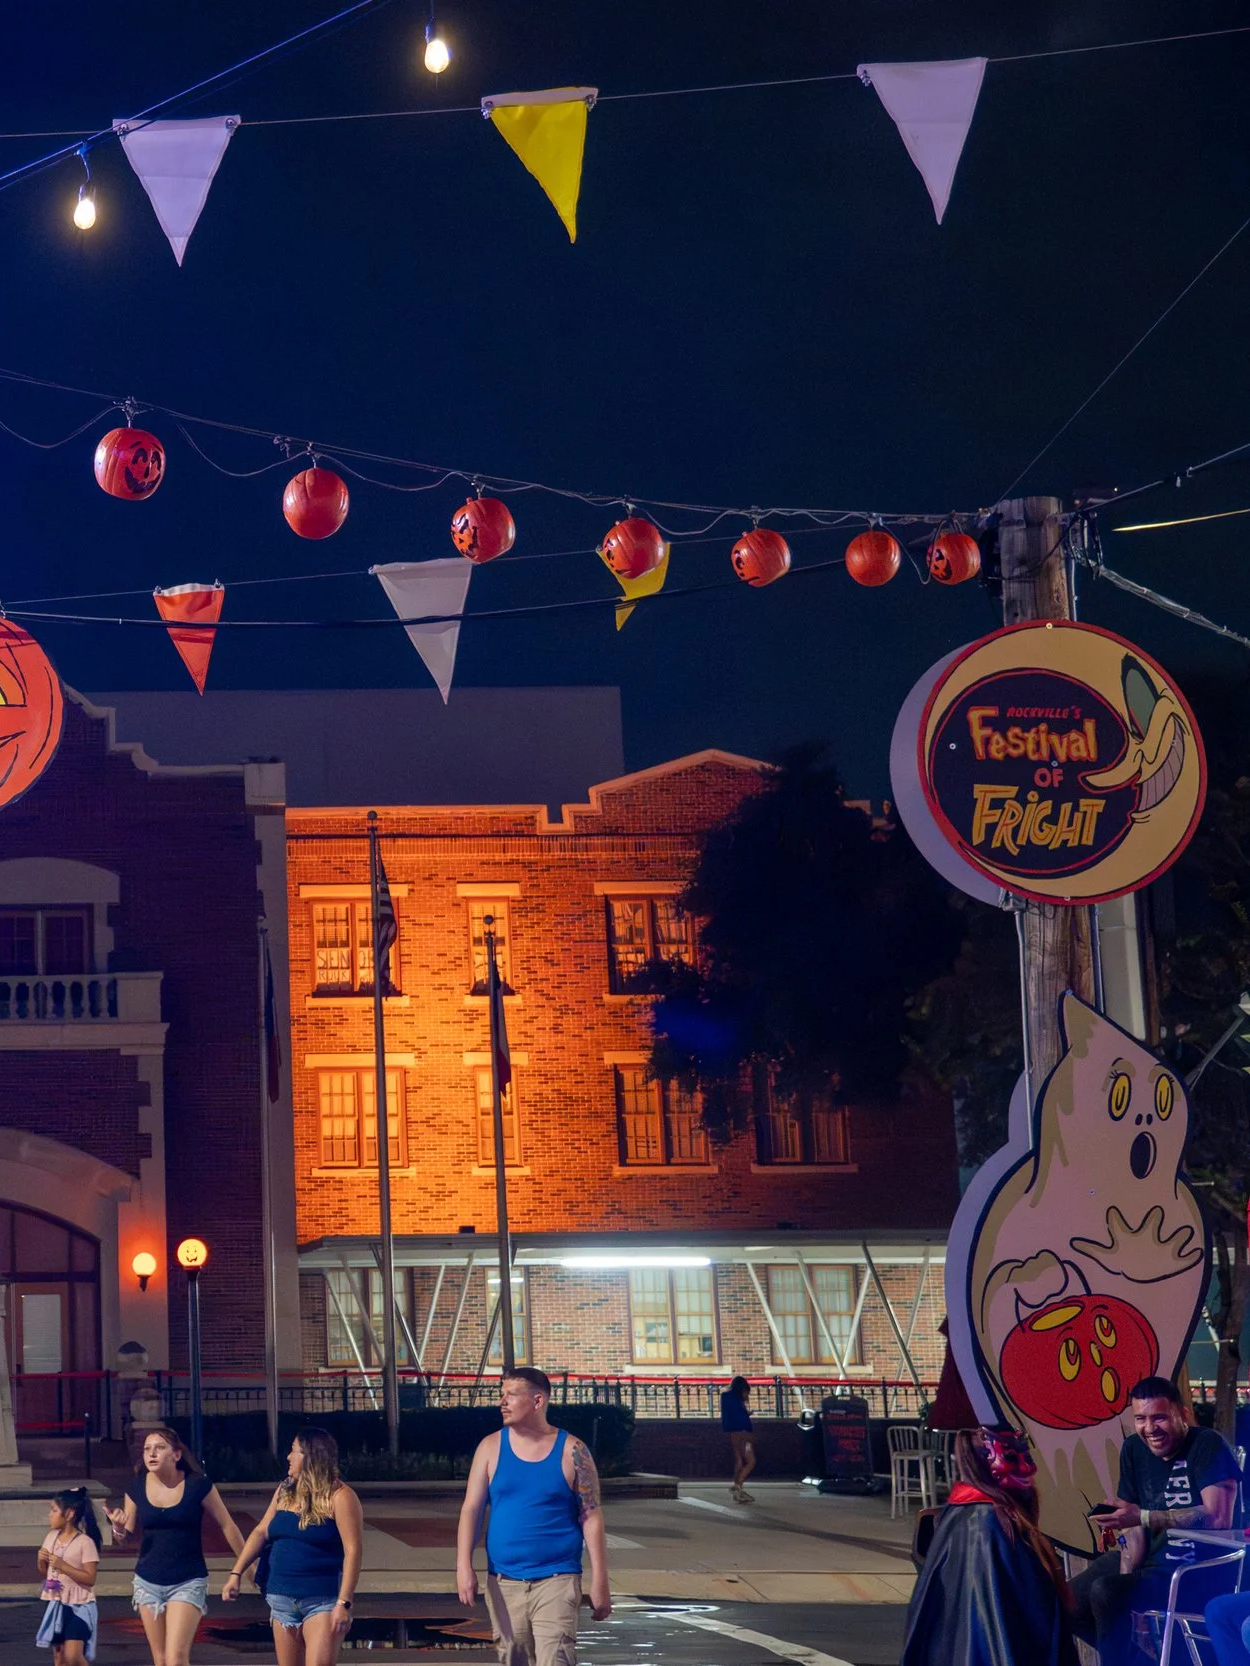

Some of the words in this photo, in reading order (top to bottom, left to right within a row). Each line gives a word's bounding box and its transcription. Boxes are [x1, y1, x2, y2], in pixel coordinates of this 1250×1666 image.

[1006, 705, 1082, 719] ROCKVILLE'S
[966, 706, 1098, 763] Festival
[1034, 767, 1064, 788] OF
